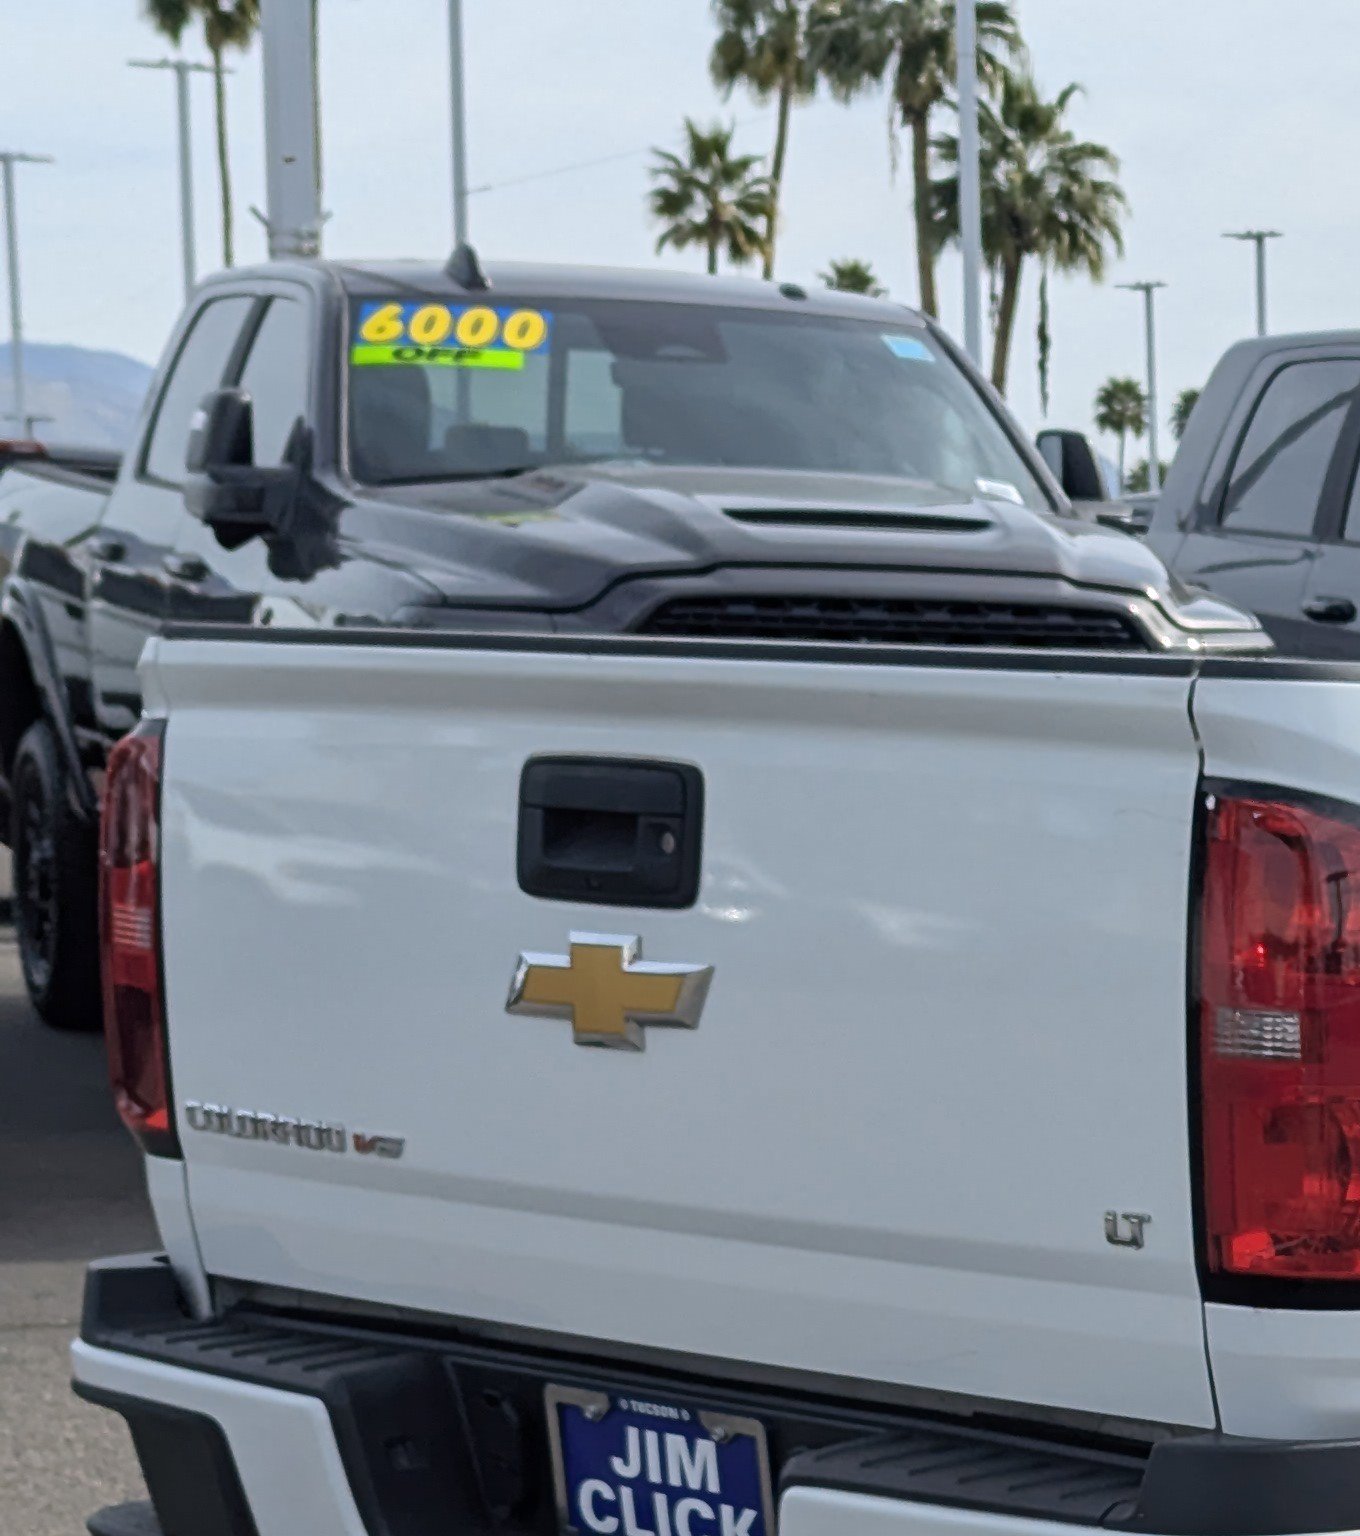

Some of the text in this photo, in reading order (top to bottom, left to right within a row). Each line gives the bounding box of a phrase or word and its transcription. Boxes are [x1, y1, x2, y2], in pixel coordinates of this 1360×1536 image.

[359, 302, 549, 350] 6000
[1104, 1210, 1152, 1250] LT
[610, 1425, 721, 1495] JIM
